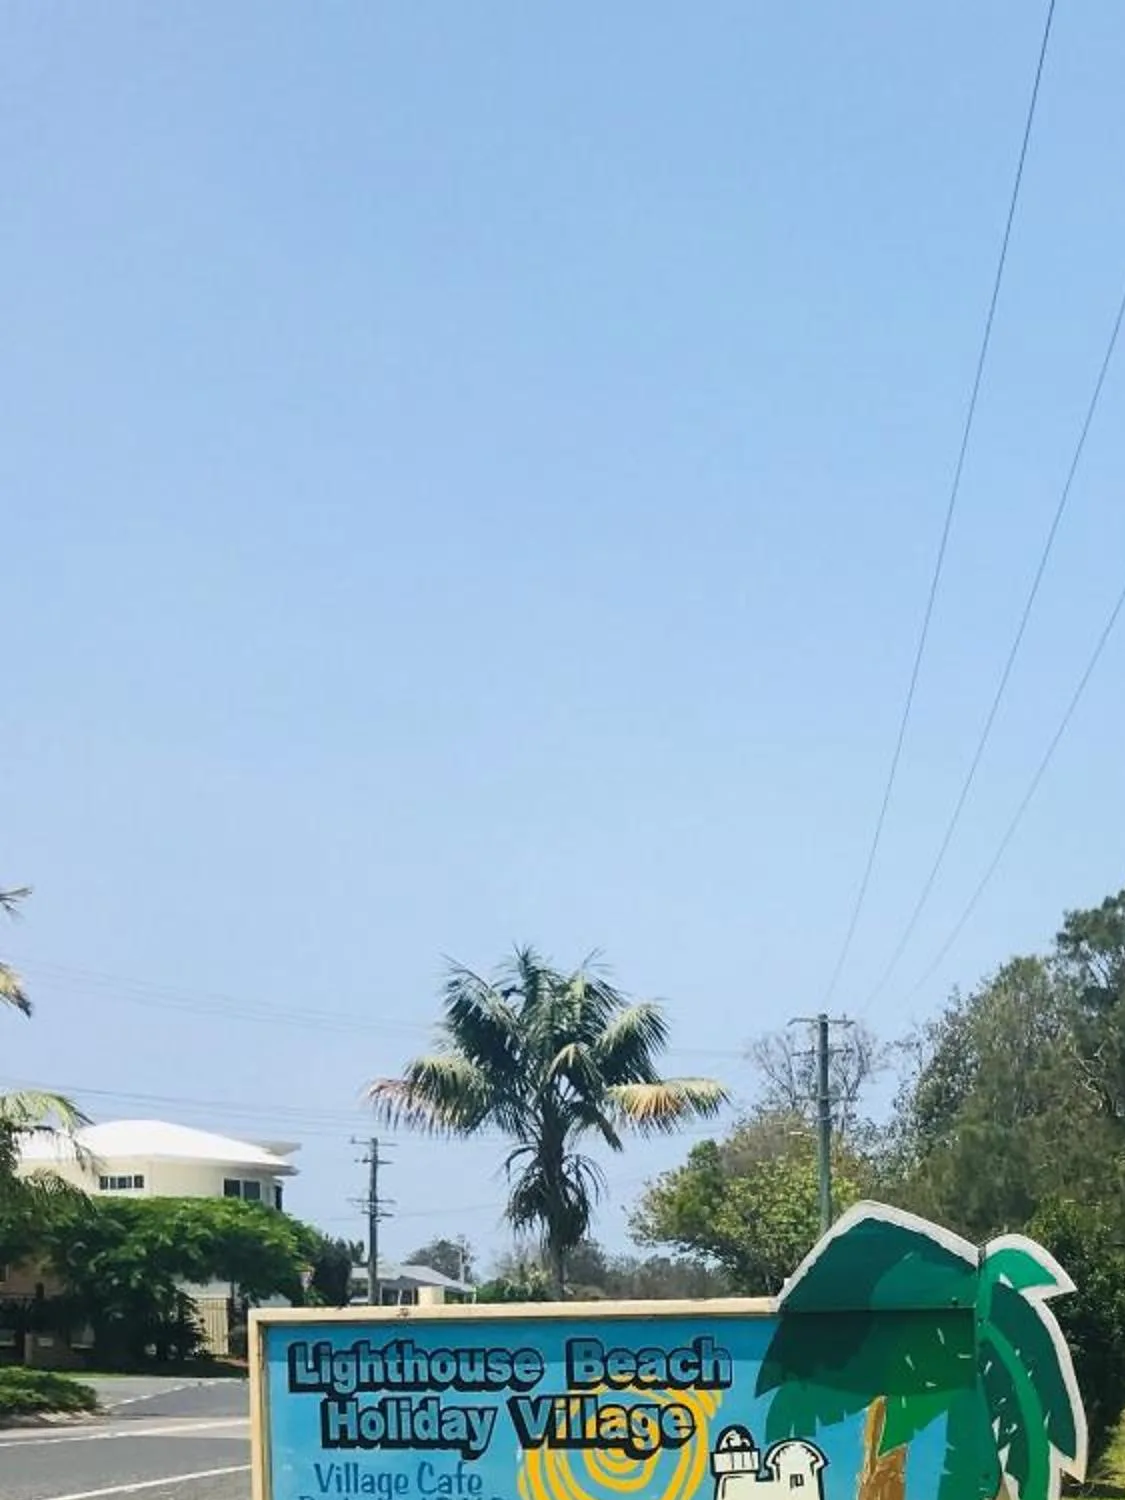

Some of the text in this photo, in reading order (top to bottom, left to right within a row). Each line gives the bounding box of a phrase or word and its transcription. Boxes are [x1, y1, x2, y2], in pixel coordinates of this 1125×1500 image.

[288, 1336, 733, 1394] Lighthouse Beach
[321, 1395, 698, 1460] Holiday Village
[417, 1461, 483, 1496] Cafe
